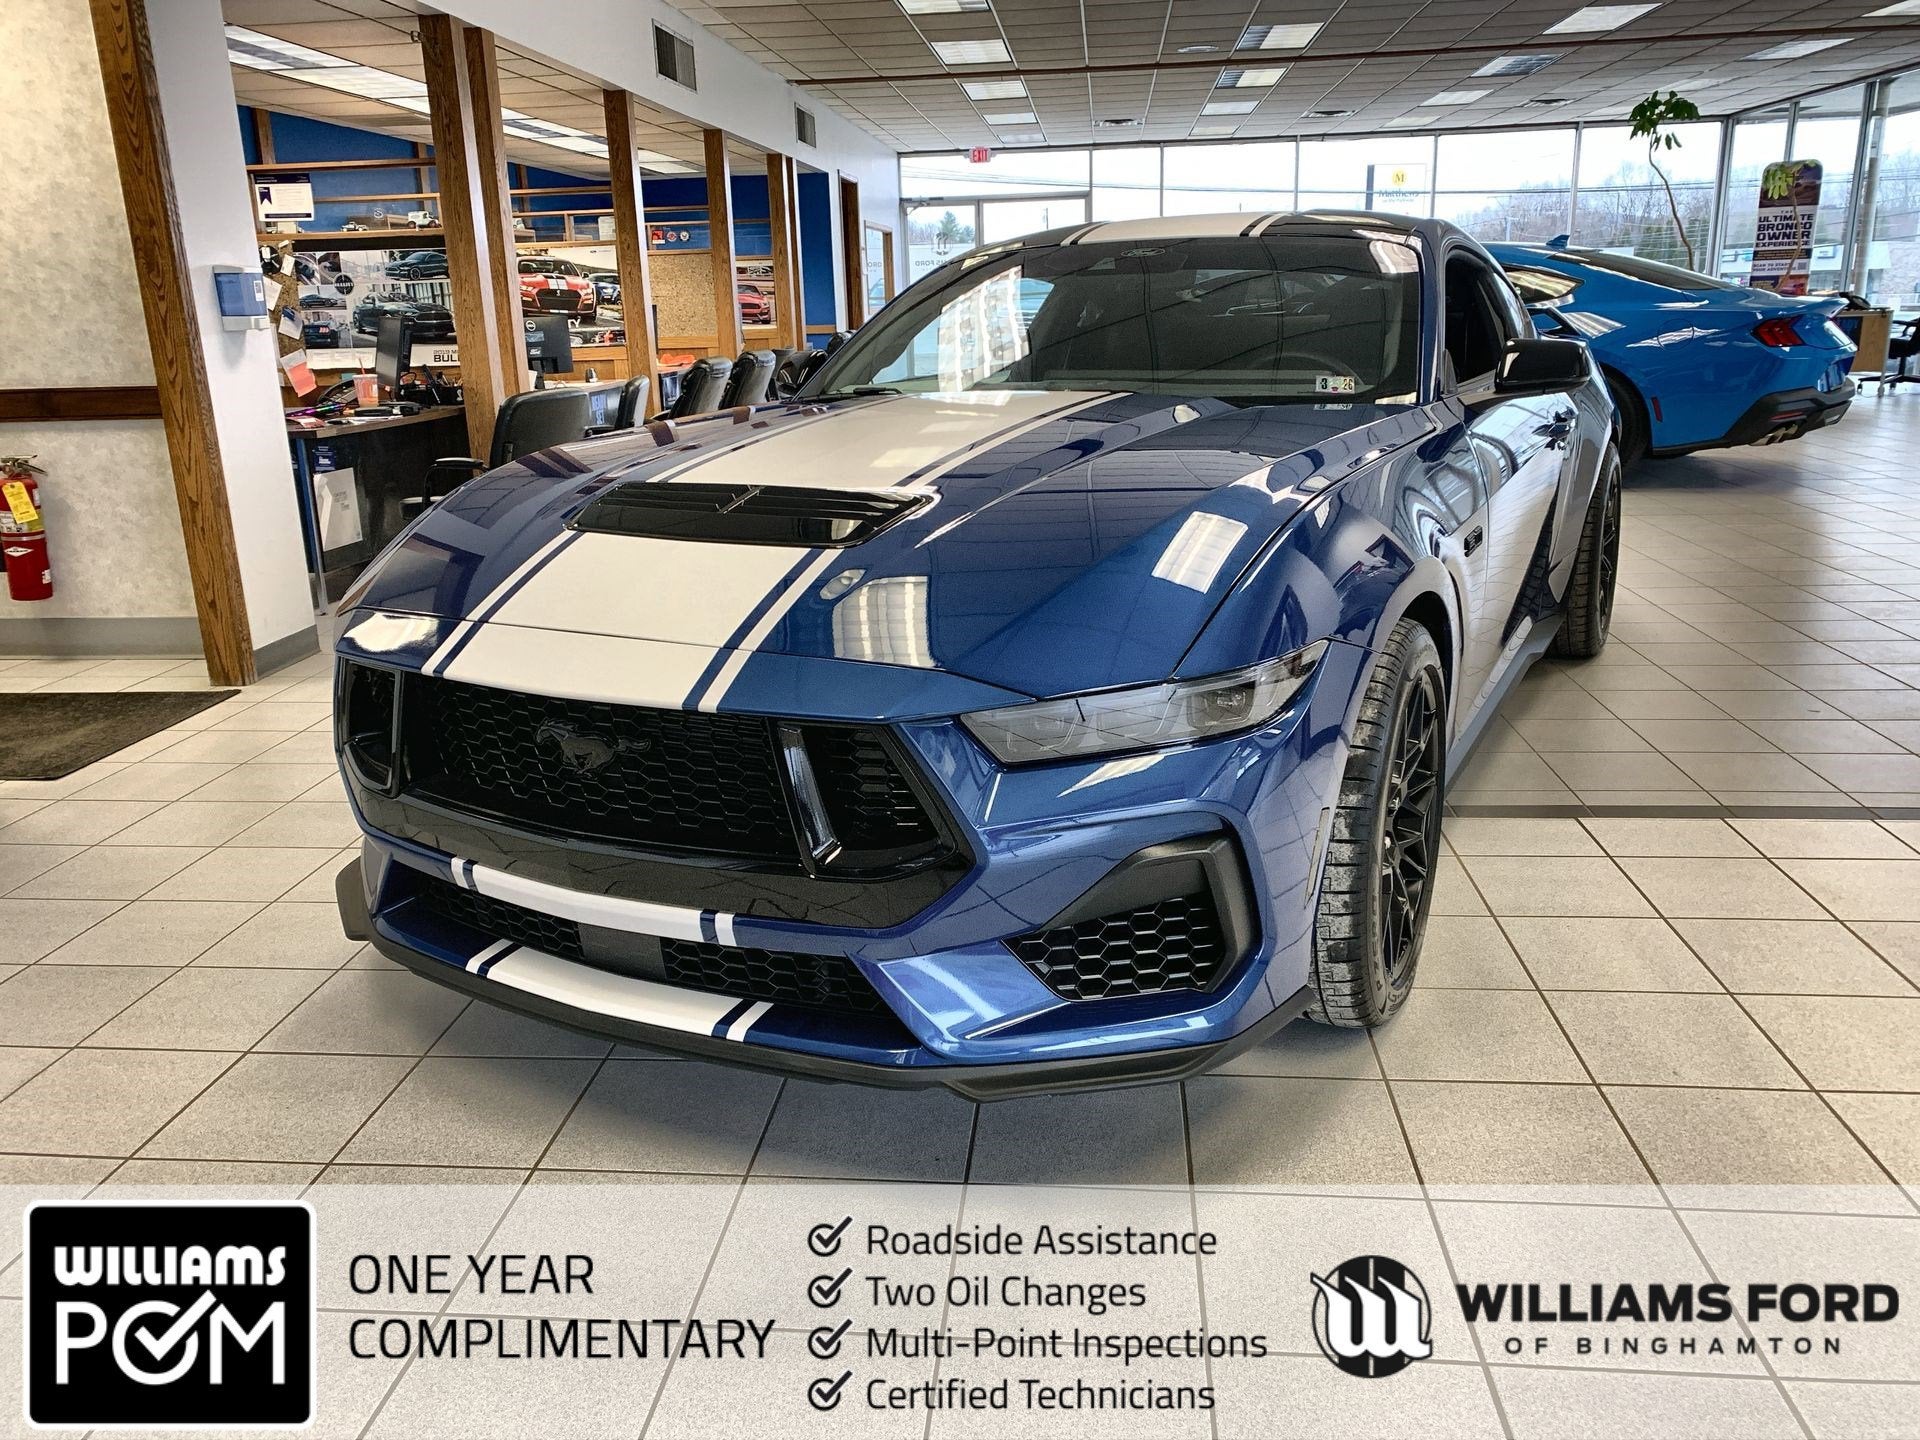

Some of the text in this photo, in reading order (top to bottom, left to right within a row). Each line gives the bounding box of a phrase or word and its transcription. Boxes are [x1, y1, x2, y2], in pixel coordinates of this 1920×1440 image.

[972, 149, 988, 162] EXIT
[1756, 230, 1811, 241] OWNER
[1321, 378, 1353, 390] 3 26
